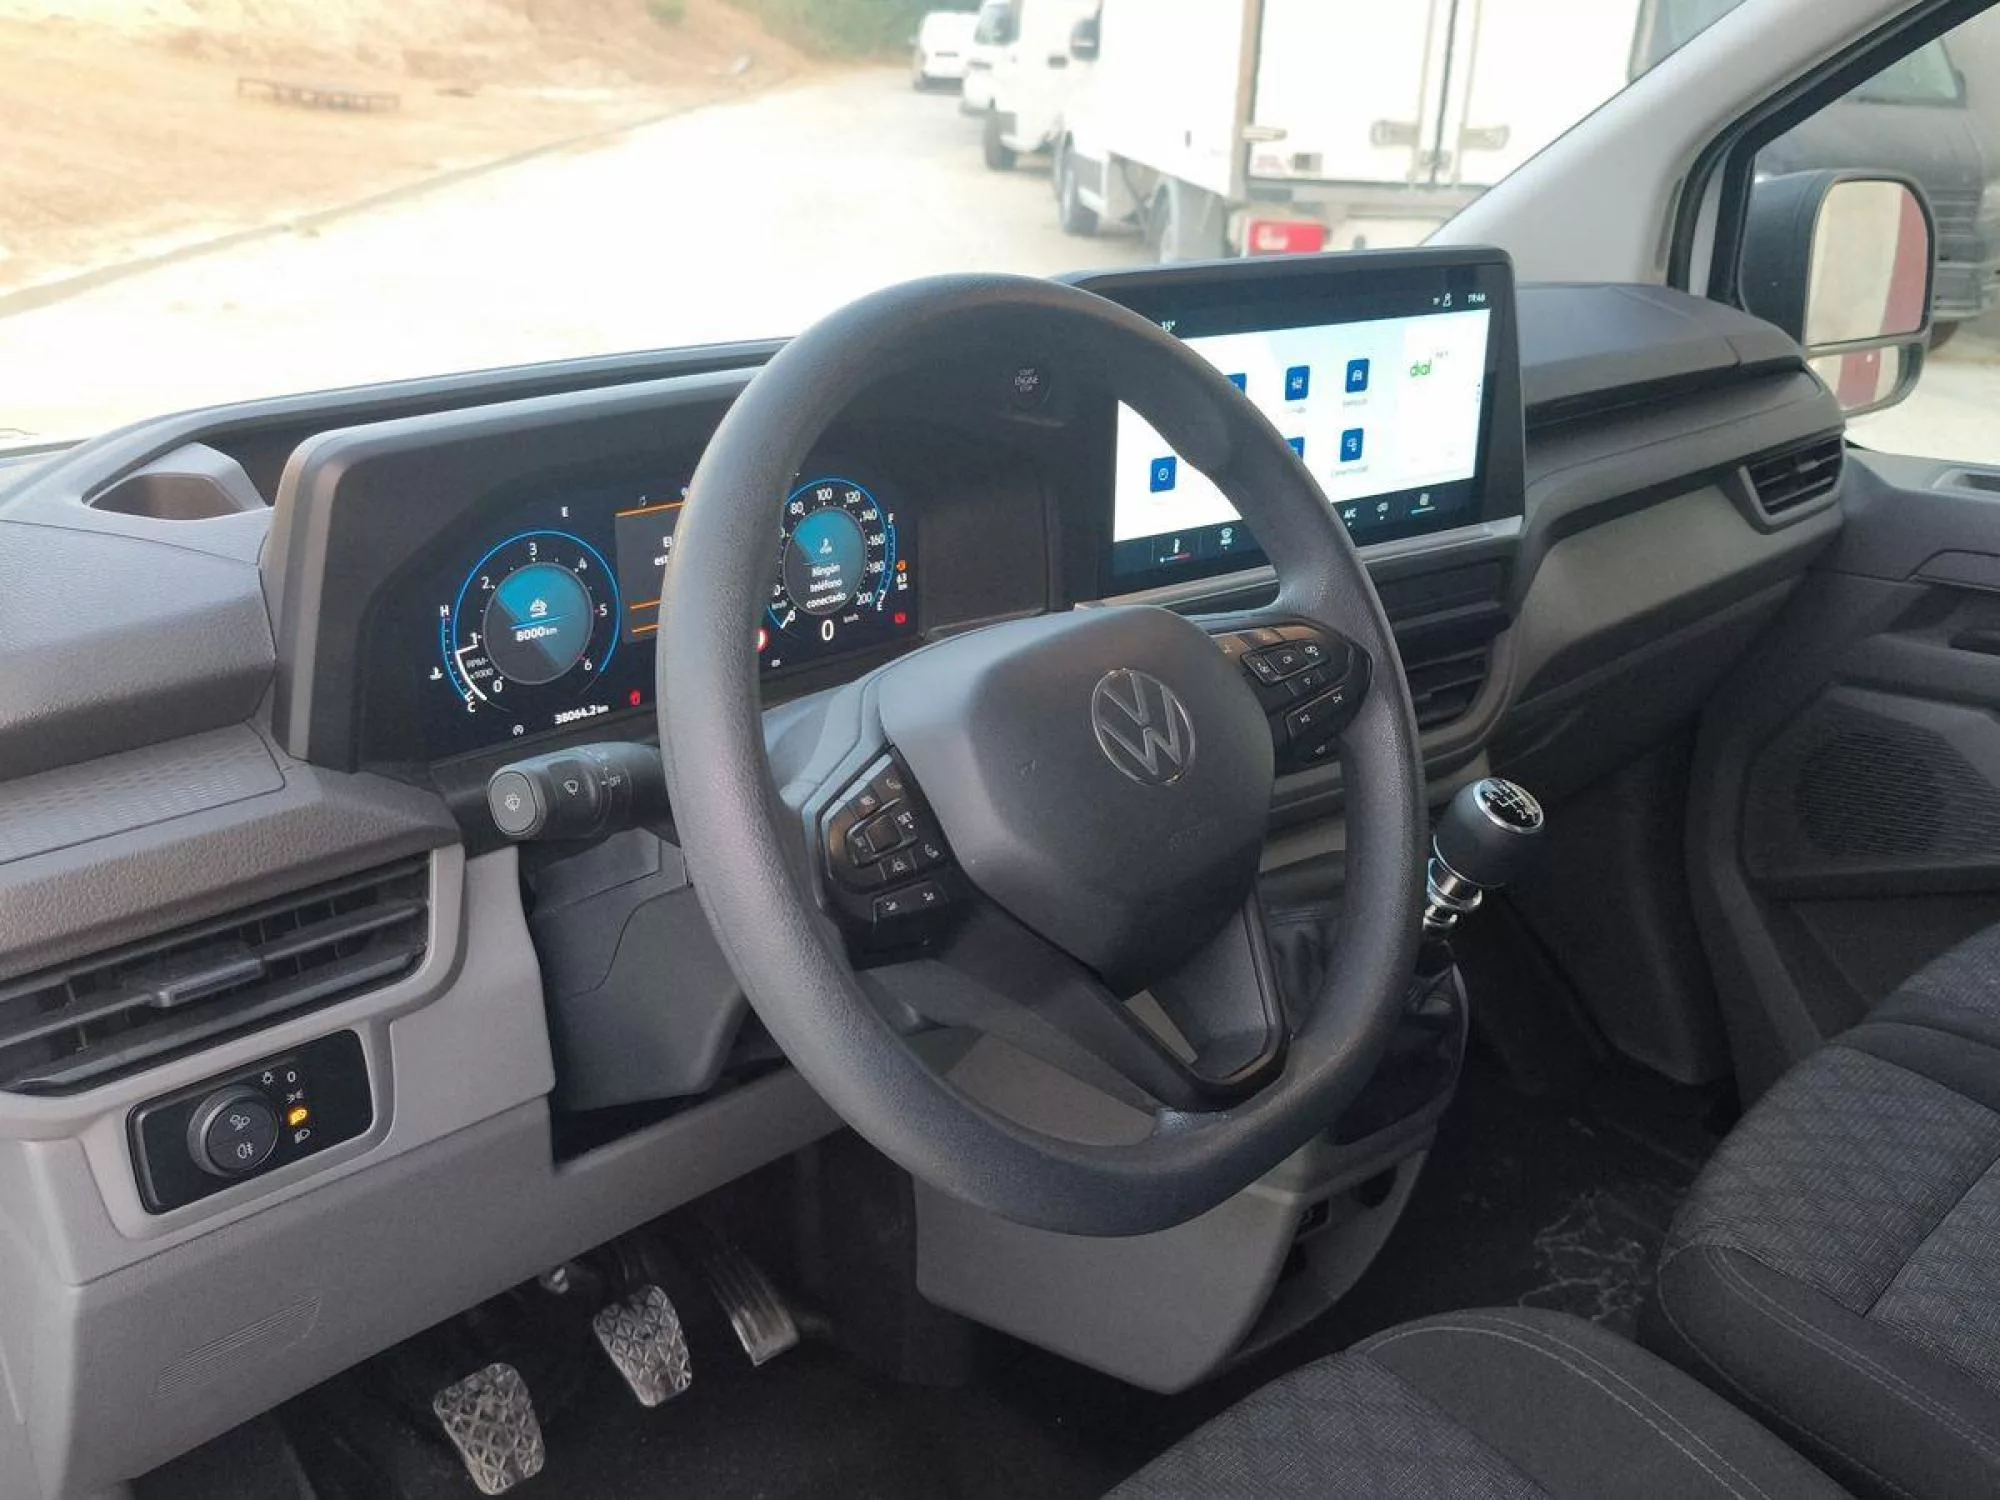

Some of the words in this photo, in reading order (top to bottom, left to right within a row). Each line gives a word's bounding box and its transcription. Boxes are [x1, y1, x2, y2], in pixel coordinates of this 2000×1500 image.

[816, 487, 832, 501] 100
[790, 501, 804, 515] 80
[529, 543, 538, 555] 3
[578, 558, 588, 569] 4
[481, 576, 491, 588] 2
[600, 604, 608, 616] 5
[821, 619, 835, 642] 0
[584, 659, 593, 672] 6
[492, 679, 503, 693] 0
